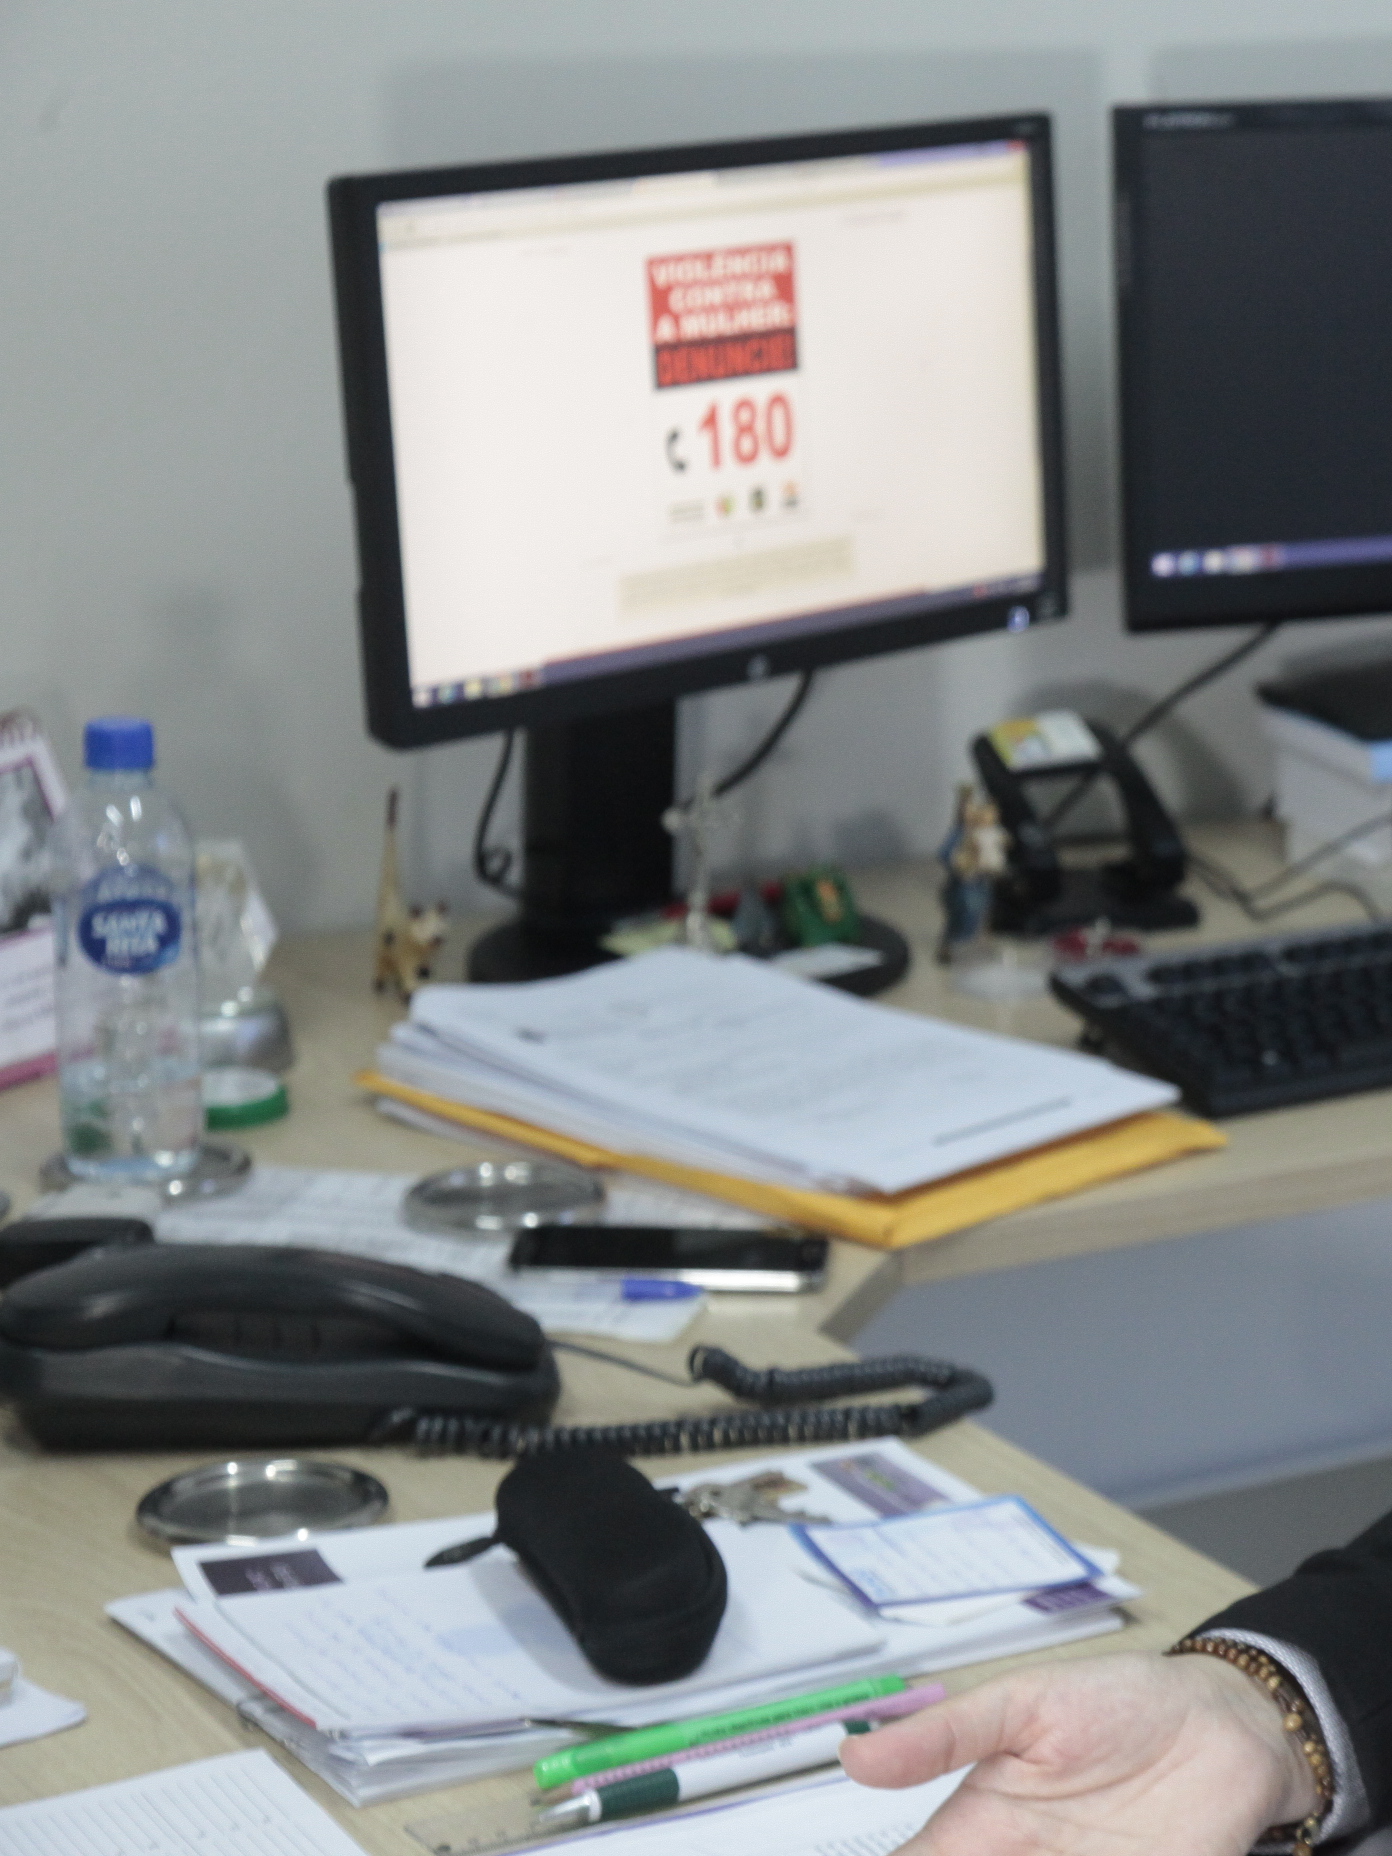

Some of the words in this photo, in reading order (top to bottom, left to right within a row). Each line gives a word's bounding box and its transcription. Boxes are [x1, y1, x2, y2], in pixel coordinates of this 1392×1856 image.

[668, 277, 776, 314] CONTRA
[654, 312, 677, 345] A
[699, 392, 792, 468] 180
